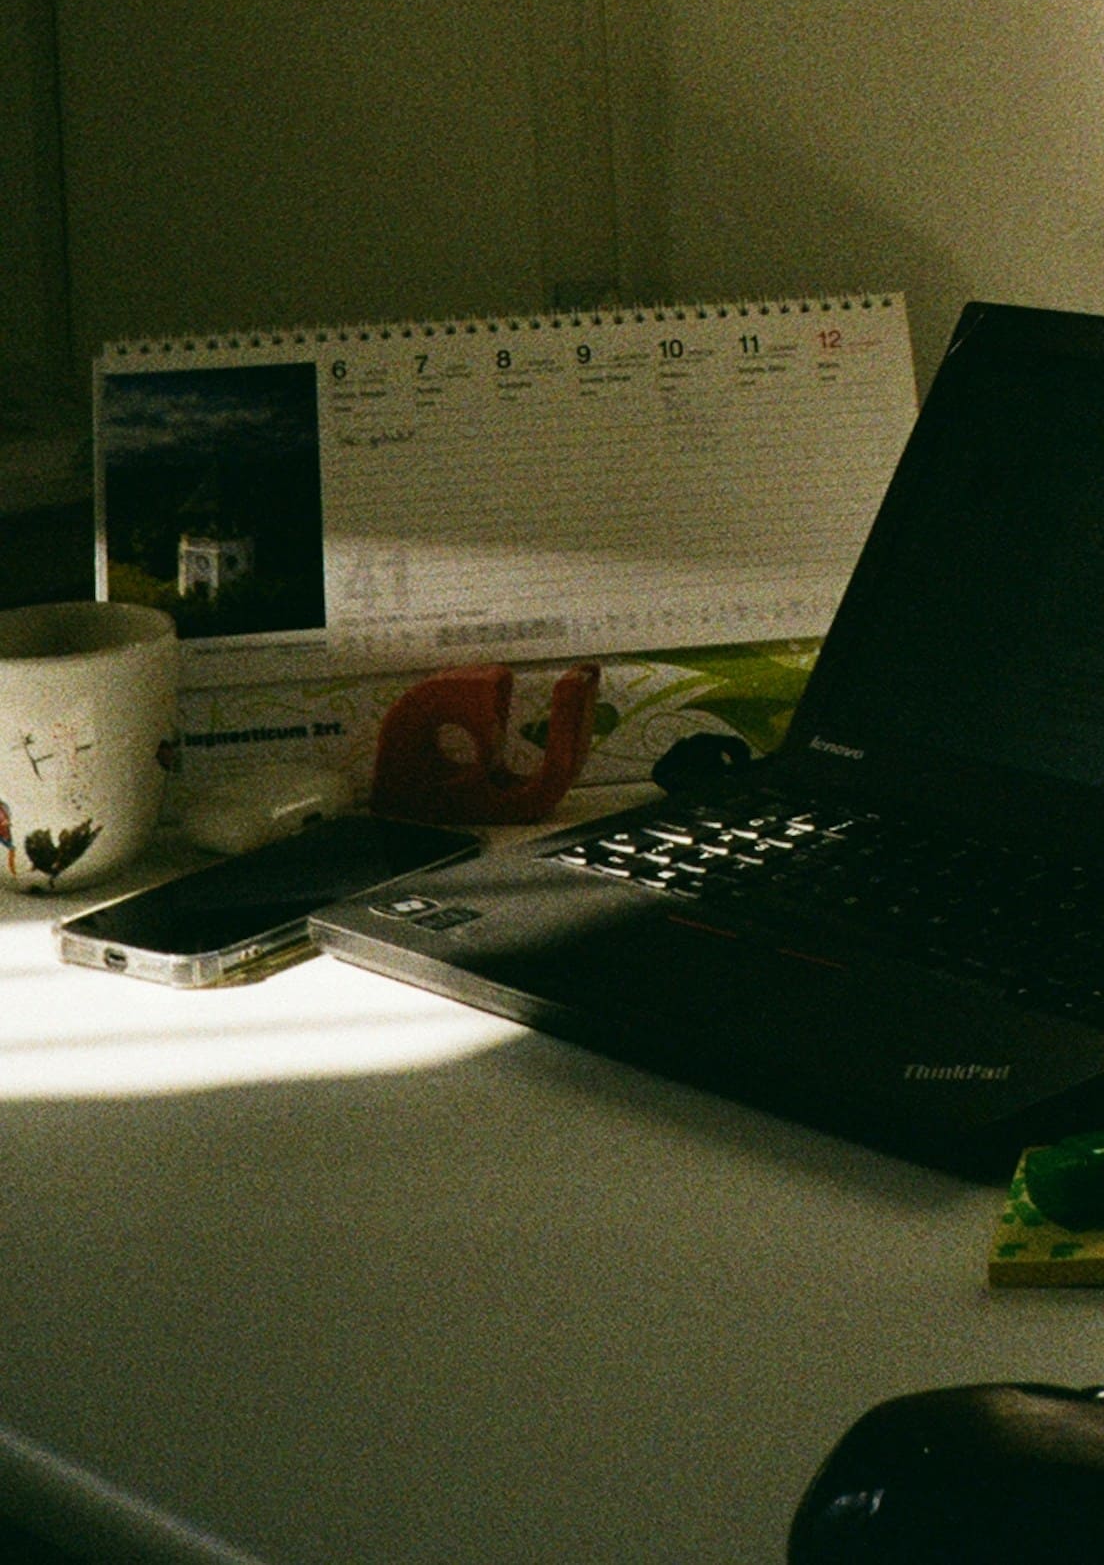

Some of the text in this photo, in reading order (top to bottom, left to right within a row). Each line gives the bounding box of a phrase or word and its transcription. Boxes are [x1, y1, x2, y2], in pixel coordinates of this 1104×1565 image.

[659, 339, 684, 358] 10
[739, 335, 760, 353] 11
[818, 330, 841, 348] 12
[415, 354, 428, 373] 7
[496, 349, 511, 368] 8
[576, 345, 591, 364] 9
[331, 360, 347, 380] 6
[808, 734, 866, 761] lenovo
[903, 1062, 1011, 1081] ThinkPad
